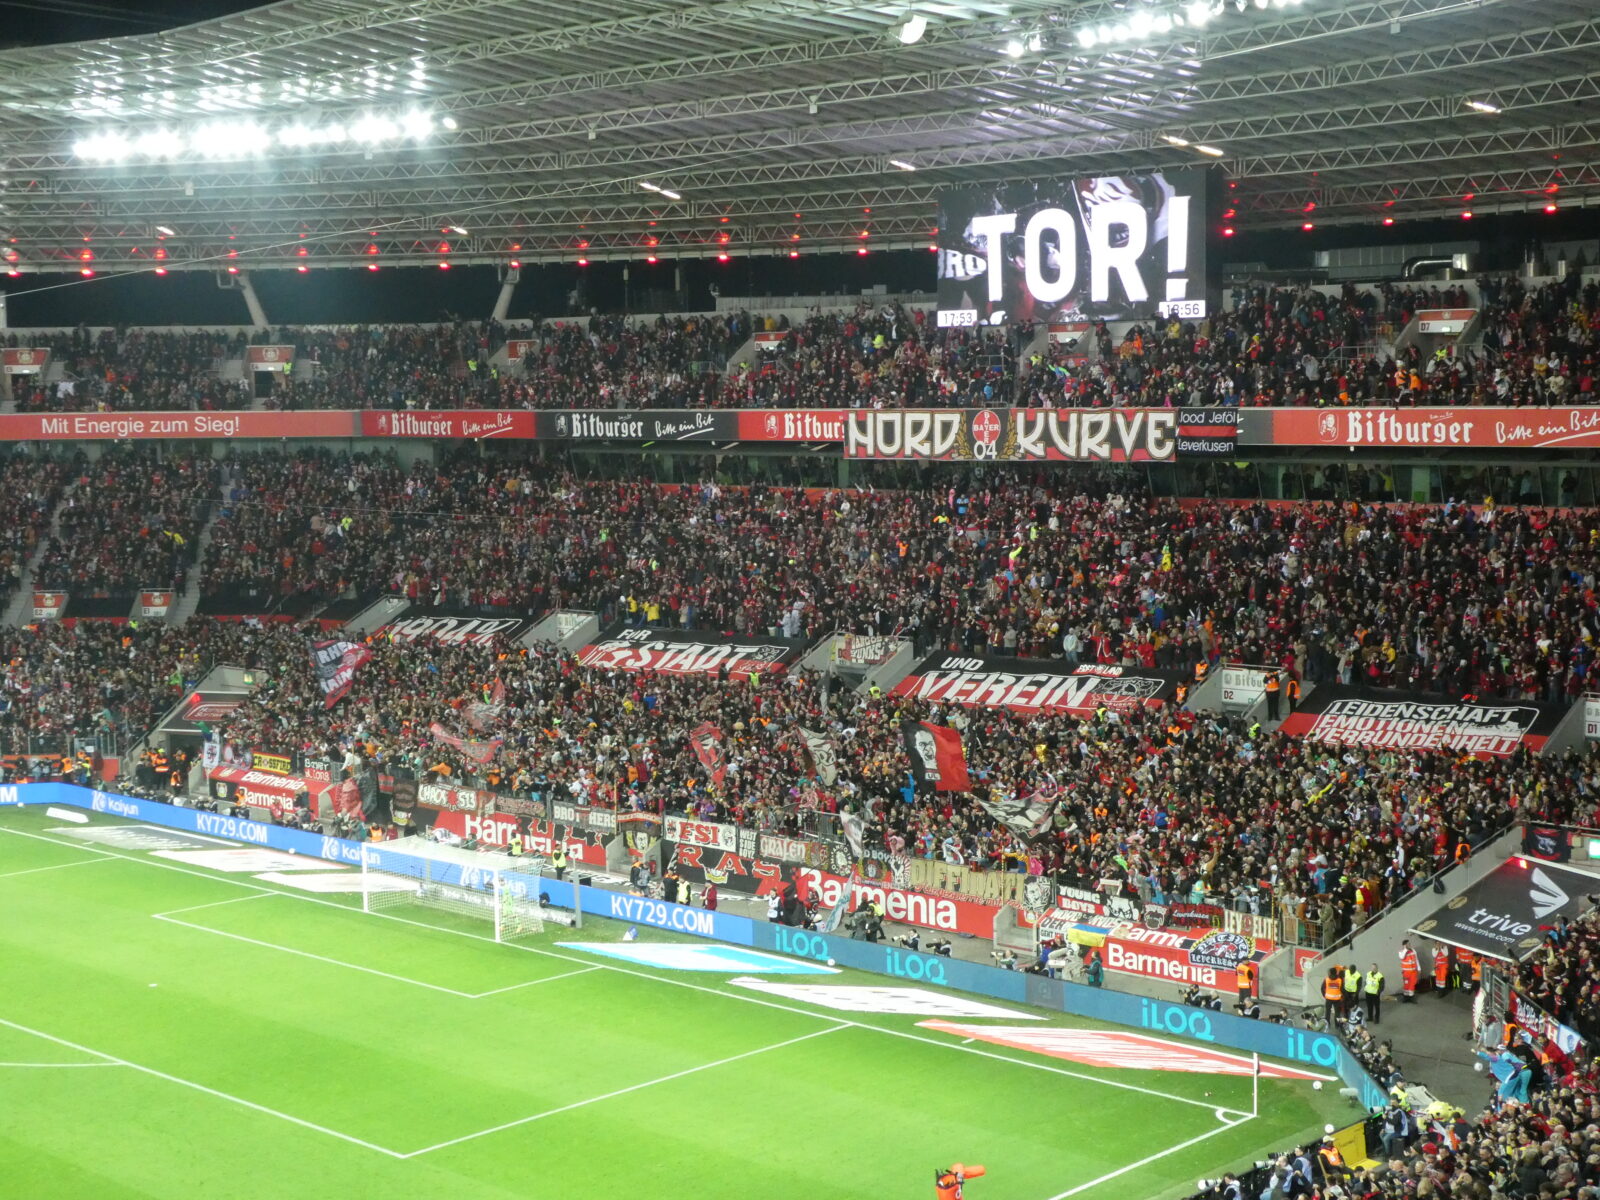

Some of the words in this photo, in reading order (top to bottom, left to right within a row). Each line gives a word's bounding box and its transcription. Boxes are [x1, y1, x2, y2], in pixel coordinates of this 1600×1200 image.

[972, 195, 1191, 303] TOR!
[944, 312, 973, 324] 17:53
[41, 418, 69, 434] Mit
[75, 417, 144, 437] Energie
[150, 419, 188, 433] zum
[194, 416, 239, 435] Sieg!
[392, 413, 452, 435] Bitburger
[462, 420, 481, 435] Bitte
[482, 421, 496, 431] ein
[497, 413, 513, 428] Bit
[571, 413, 643, 437] Bitburger
[655, 420, 677, 437] Bitte
[679, 422, 695, 432] ein
[696, 413, 715, 429] Bit
[848, 412, 961, 456] NORD
[1016, 411, 1174, 459] KURVE
[1346, 411, 1474, 443] Bitburger
[1495, 421, 1533, 443] Bitte
[1538, 420, 1567, 436] ein
[1570, 410, 1600, 431] Bit
[973, 440, 998, 460] 04
[1178, 438, 1234, 452] Leverkusen
[628, 642, 760, 671] STADT
[941, 656, 984, 670] UND
[917, 672, 1101, 706] VEREIN
[1235, 673, 1265, 688] Bitbu
[1223, 690, 1234, 700] D2
[1329, 700, 1519, 723] LEIDENSCHAFT
[1319, 714, 1471, 735] EMOTIONEN
[1587, 723, 1597, 734] D1
[1312, 727, 1520, 752] VERBUNDENHEIT
[241, 771, 305, 790] Barmenia
[108, 797, 139, 816] kaiyun
[196, 813, 268, 843] KY729.COM
[342, 844, 380, 864] kaiun
[1059, 884, 1101, 904] YOUNG
[611, 895, 714, 935] KY729.COM
[1468, 908, 1532, 936] trive
[775, 925, 830, 961] iLOQ
[1108, 922, 1187, 949] Barme
[1454, 921, 1516, 944] www.trive.com
[886, 947, 948, 985] iLOQ
[1108, 943, 1217, 986] Barmenia
[1191, 953, 1238, 968] LEVERKUSE
[1142, 998, 1215, 1041] iLOQ
